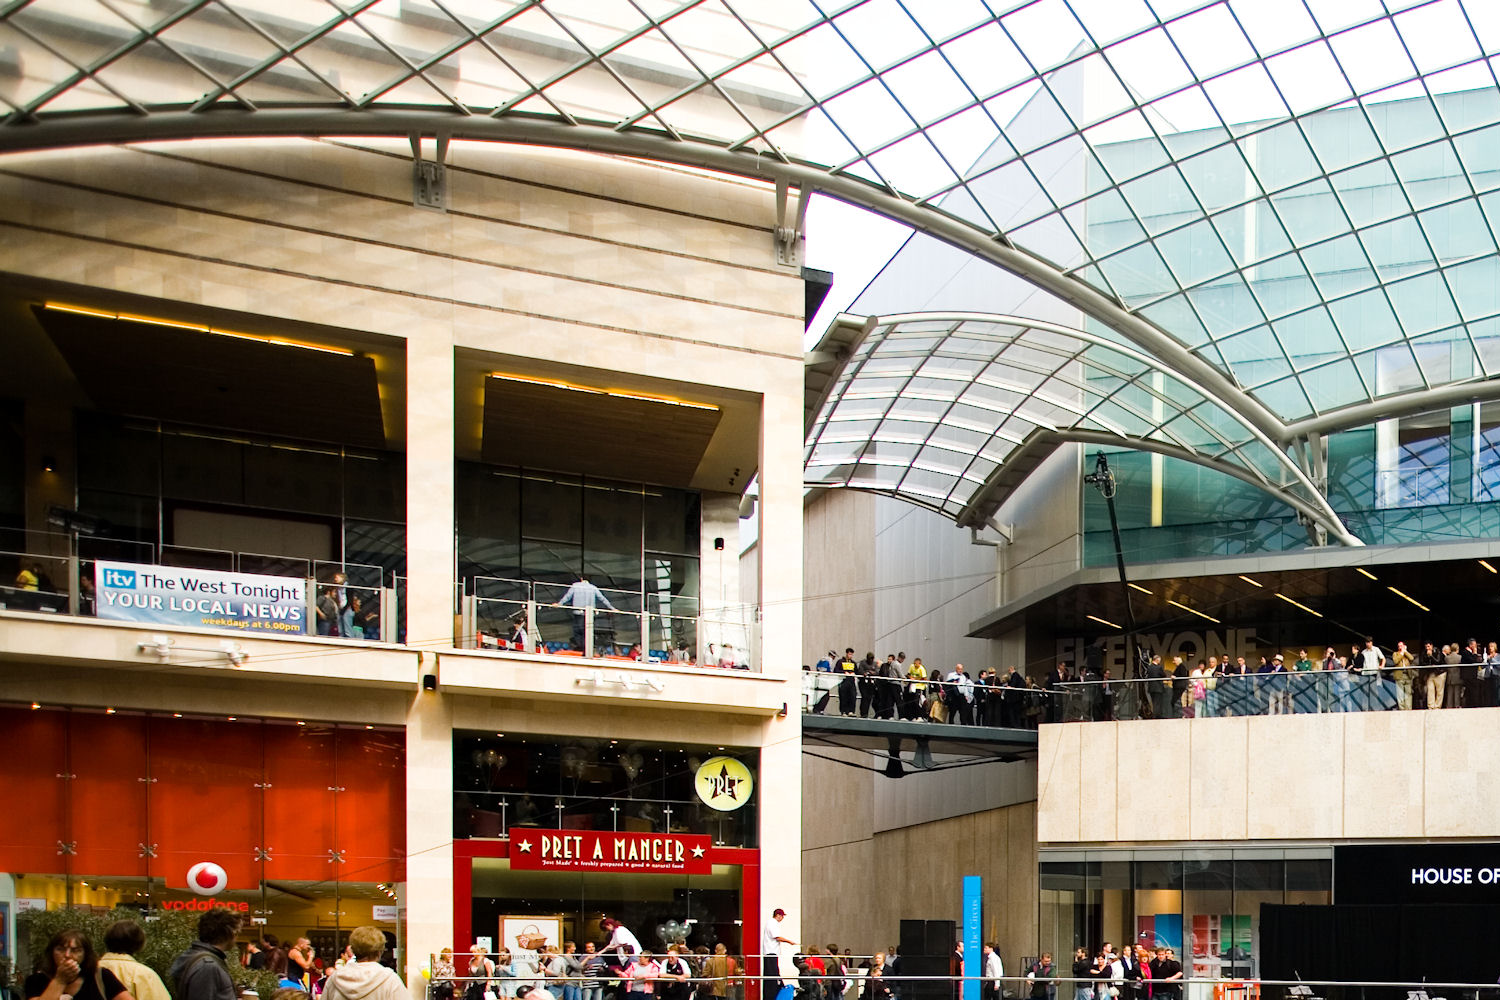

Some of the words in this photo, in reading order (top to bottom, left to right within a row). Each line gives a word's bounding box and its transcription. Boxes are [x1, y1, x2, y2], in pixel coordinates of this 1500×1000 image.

[105, 570, 134, 587] itv
[141, 574, 176, 590] The
[180, 577, 227, 595] West
[232, 582, 300, 603] Tonight
[104, 591, 164, 611] YOUR
[169, 596, 238, 616] LOCAL
[242, 603, 301, 621] NEWS
[201, 617, 250, 629] weekdays
[252, 621, 262, 629] at
[264, 622, 300, 632] 6.00pm
[707, 775, 740, 796] PRET
[541, 835, 583, 859] PRET
[593, 837, 604, 860] A
[613, 838, 685, 862] MANGER
[1411, 868, 1473, 885] HOUSE
